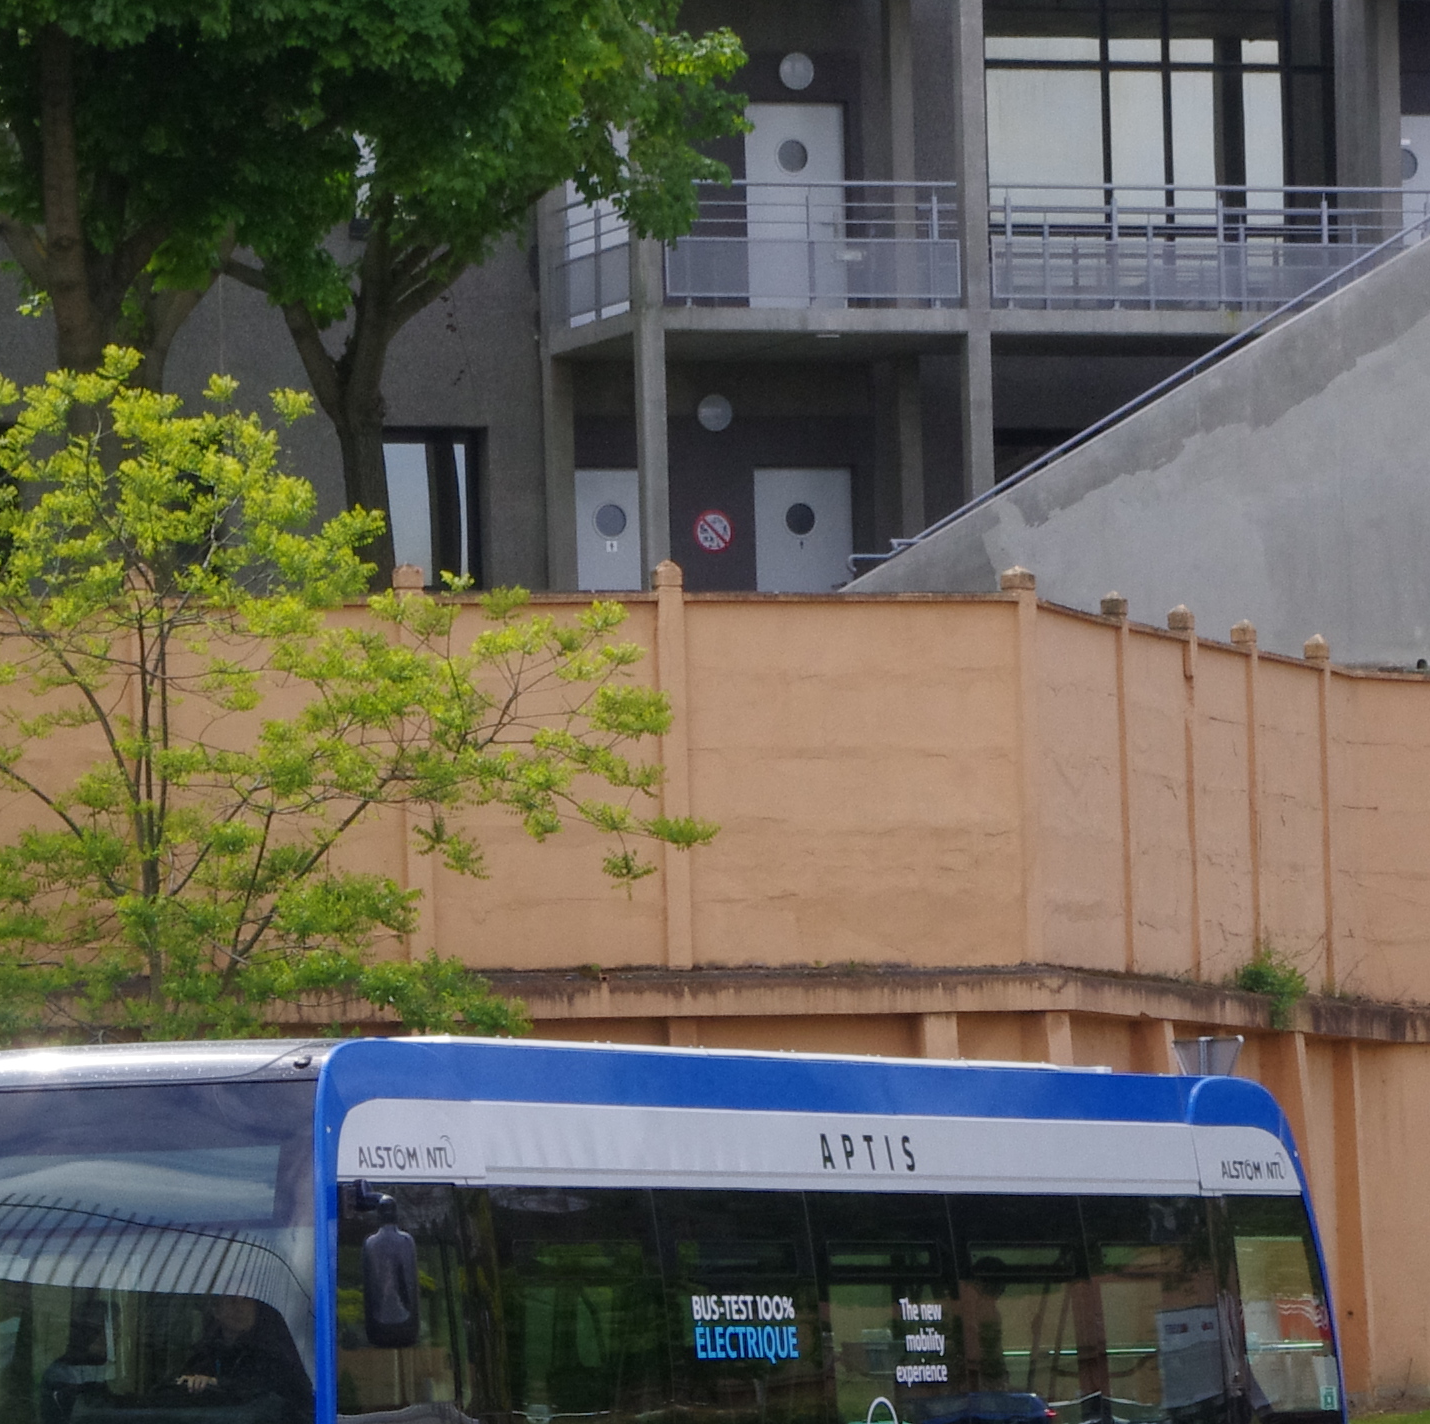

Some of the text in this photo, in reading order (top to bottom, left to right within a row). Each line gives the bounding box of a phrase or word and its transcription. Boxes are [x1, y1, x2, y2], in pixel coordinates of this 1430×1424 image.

[358, 1144, 420, 1171] ALSTOM
[819, 1133, 916, 1172] APTIS
[1221, 1159, 1262, 1181] ALSTOM
[691, 1295, 796, 1320] BUS-TEST 100%
[899, 1297, 942, 1321] The new
[695, 1321, 800, 1364] ÉLECTRIQUE
[906, 1327, 945, 1356] mobility
[896, 1358, 948, 1388] experience
